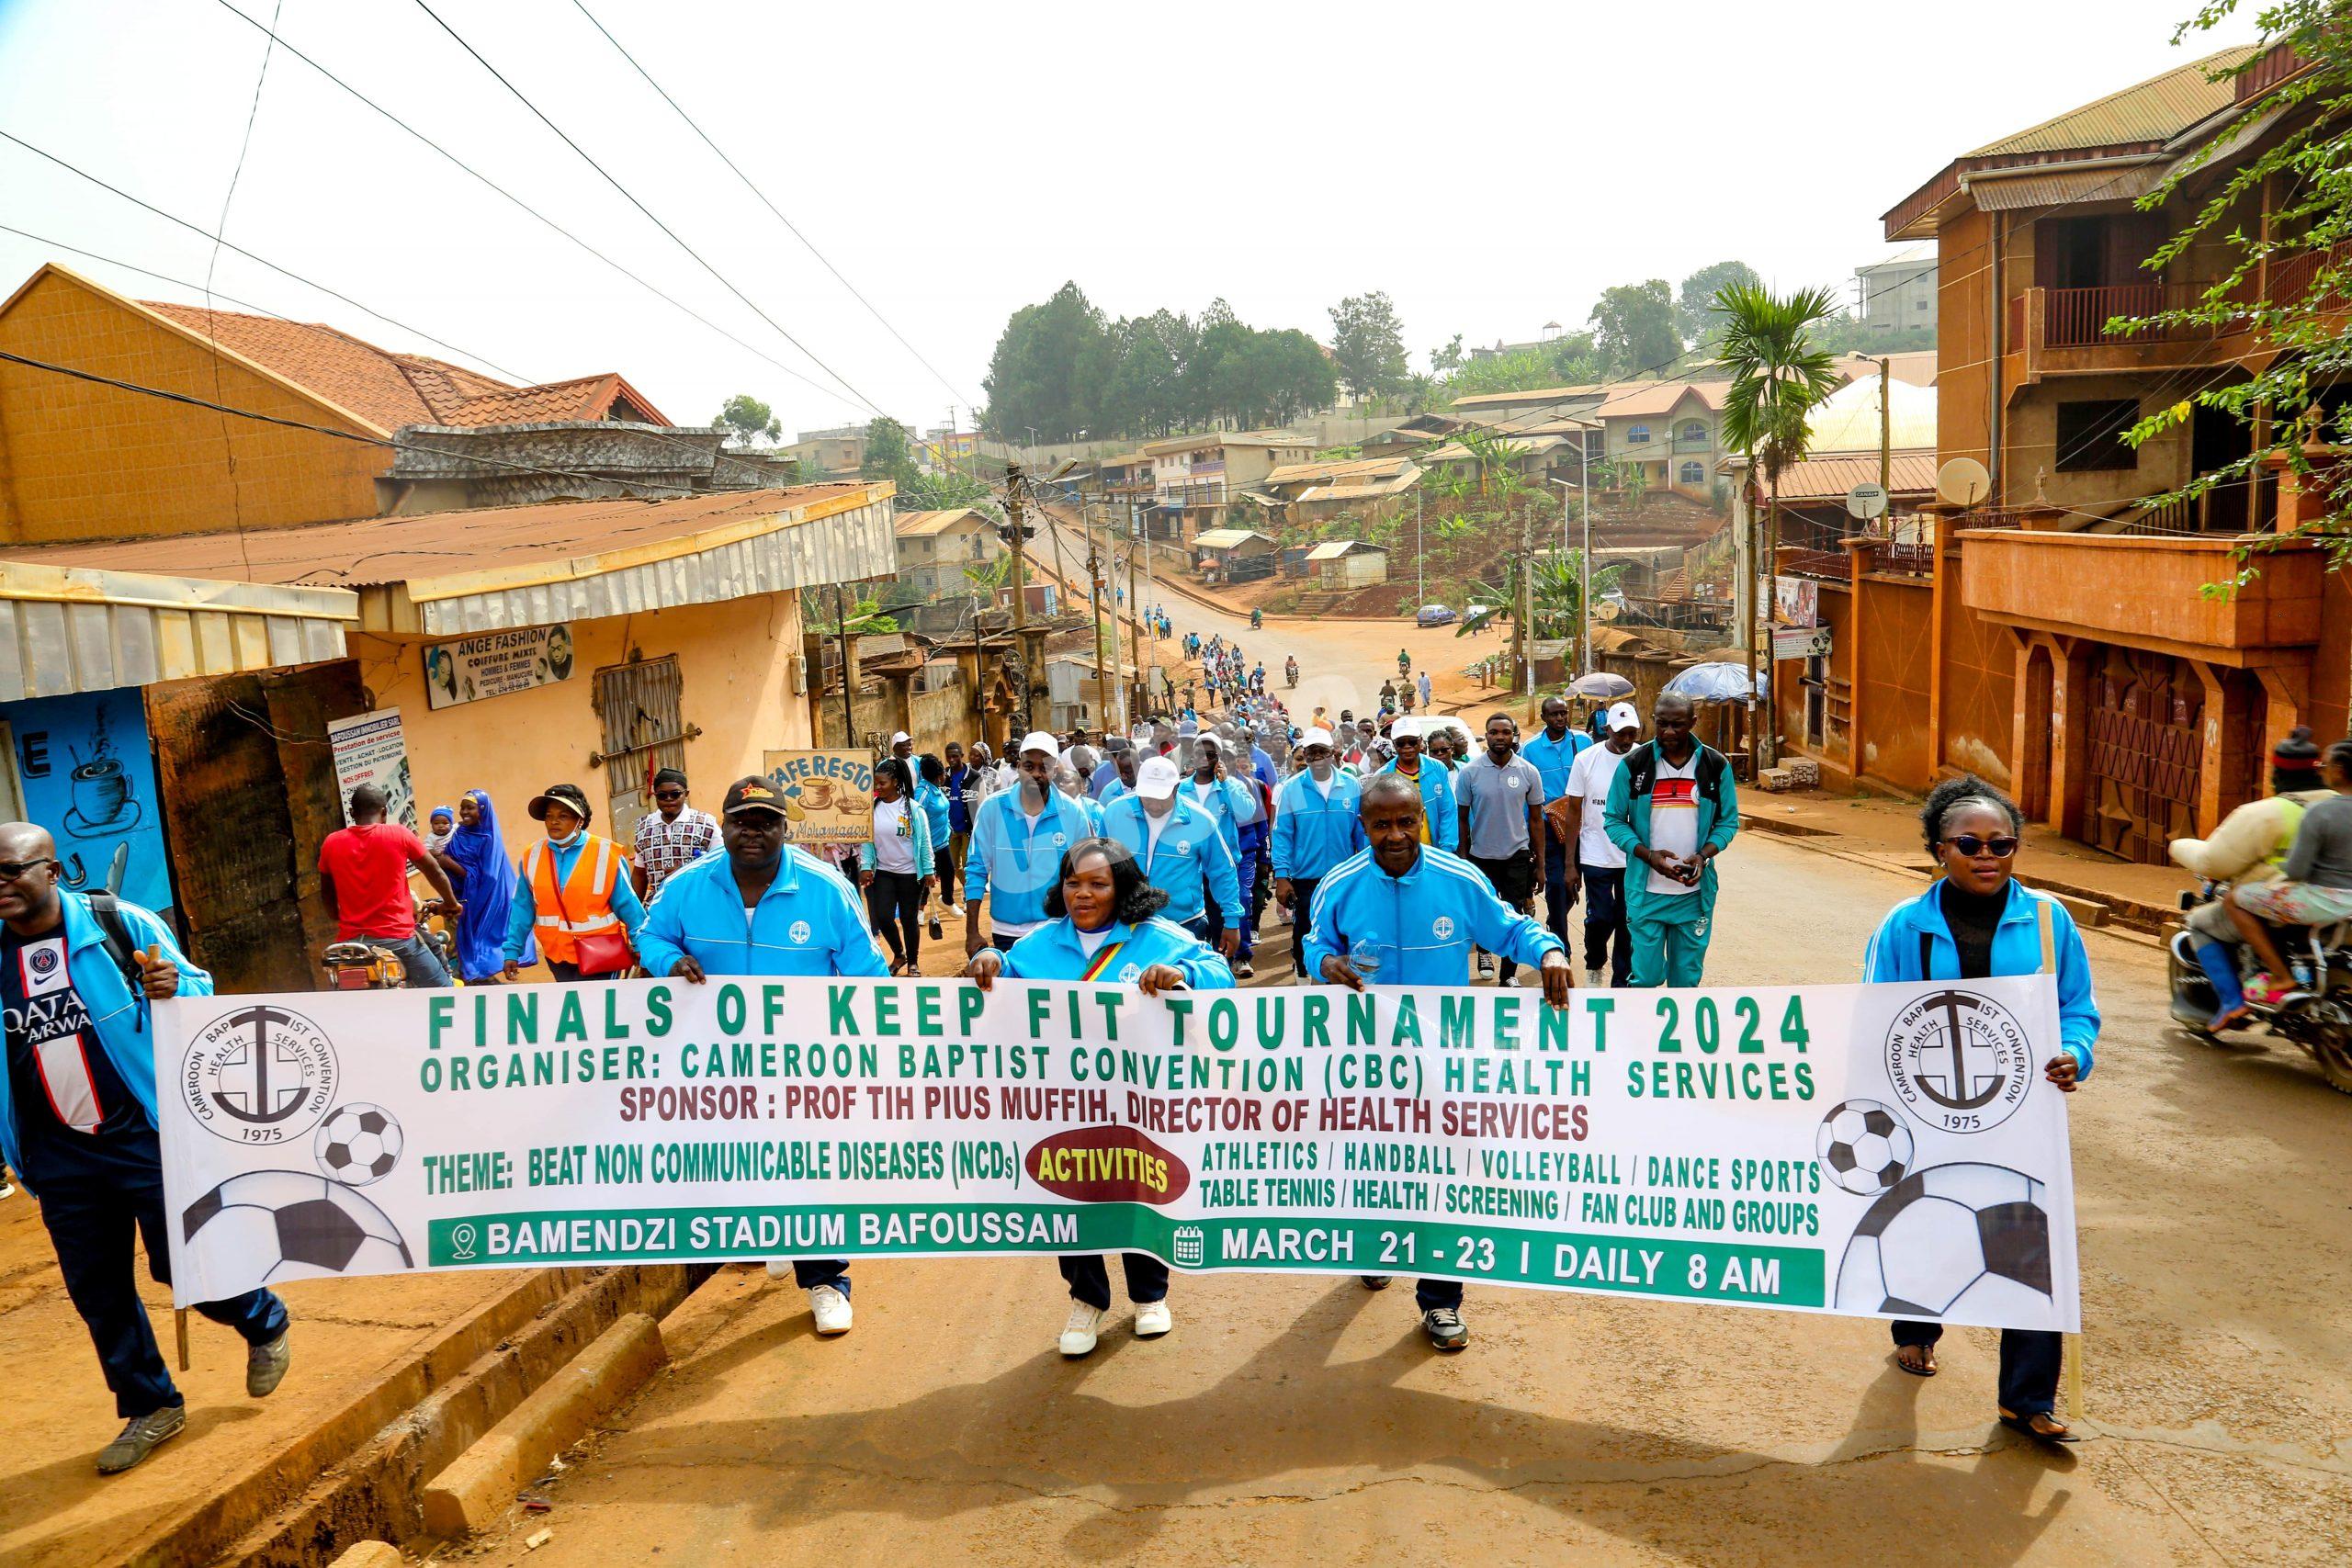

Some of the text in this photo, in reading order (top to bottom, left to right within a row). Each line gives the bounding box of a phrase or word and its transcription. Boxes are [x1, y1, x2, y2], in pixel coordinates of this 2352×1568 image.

[458, 628, 547, 657] ANGE FASHION
[468, 647, 537, 668] COIFFURE MIXTE
[481, 664, 503, 677] HOMMES
[510, 659, 531, 672] FEMMES
[333, 740, 366, 753] Prestation
[335, 756, 354, 766] VENTE
[357, 750, 375, 760] ACHAT
[379, 741, 404, 753] LOCATION
[339, 761, 363, 773] GESTION
[343, 769, 374, 784] NOS OFFRES
[812, 755, 872, 792] RESTO
[4, 989, 88, 1034] QATA
[28, 1013, 94, 1043] AIRWA
[429, 983, 1811, 1054] FINALS OF KEEP FIT TOURNAMENT 2024
[208, 1032, 315, 1077] HEALTH SERVICES
[1891, 1033, 1917, 1102] CAMEROON
[2000, 1021, 2025, 1103] CONVENTION
[1908, 1016, 2008, 1065] HEALTH SERVICES
[187, 1051, 214, 1121] CAMEROON
[309, 1036, 332, 1114] CONVENTION
[421, 1043, 1815, 1100] ORGANISER: CAMEROON BAPTIST CONVENTION (CBC) HEALTH SERVICES
[243, 1127, 282, 1142] 1975
[786, 1085, 857, 1120] PROF
[866, 1086, 913, 1120] TIH
[924, 1086, 991, 1121] PIUS
[1001, 1087, 1117, 1127] MUFFIH,
[1127, 1090, 1262, 1133] DIRECTOR
[1272, 1099, 1309, 1133] OF
[1319, 1096, 1430, 1134] HEALTH
[1442, 1100, 1589, 1141] SERVICES
[1943, 1114, 1981, 1130] 1975
[423, 1140, 1021, 1195] THEME: BEAT NON COMMUNICABLE DISEASES (NCDs)
[1038, 1147, 1169, 1194] ACTIVITIES
[1201, 1142, 1318, 1171] ATHLETICS
[1344, 1142, 1456, 1175] HANDBALL
[1481, 1149, 1621, 1185] VOLLEYBALL
[1647, 1156, 1720, 1190] DANCE
[1731, 1158, 1821, 1194] SPORTS
[1200, 1179, 1258, 1208] TABLE
[1264, 1178, 1335, 1209] TENNIS
[1352, 1179, 1428, 1212] HEALTH
[1445, 1183, 1558, 1221] SCREENING
[1581, 1192, 1618, 1224] FAN
[1624, 1194, 1677, 1228] CLUB
[1683, 1198, 1725, 1231] AND
[1733, 1199, 1819, 1236] GROUPS
[488, 1212, 1079, 1255] BAMENDZI STADIUM BAFOUSSAM
[1222, 1228, 1354, 1263] MARCH
[1379, 1231, 1416, 1265] 21
[1455, 1235, 1497, 1271] 23
[1554, 1244, 1665, 1285] DAILY
[1688, 1253, 1708, 1291] 8
[1719, 1256, 1781, 1296] AM
